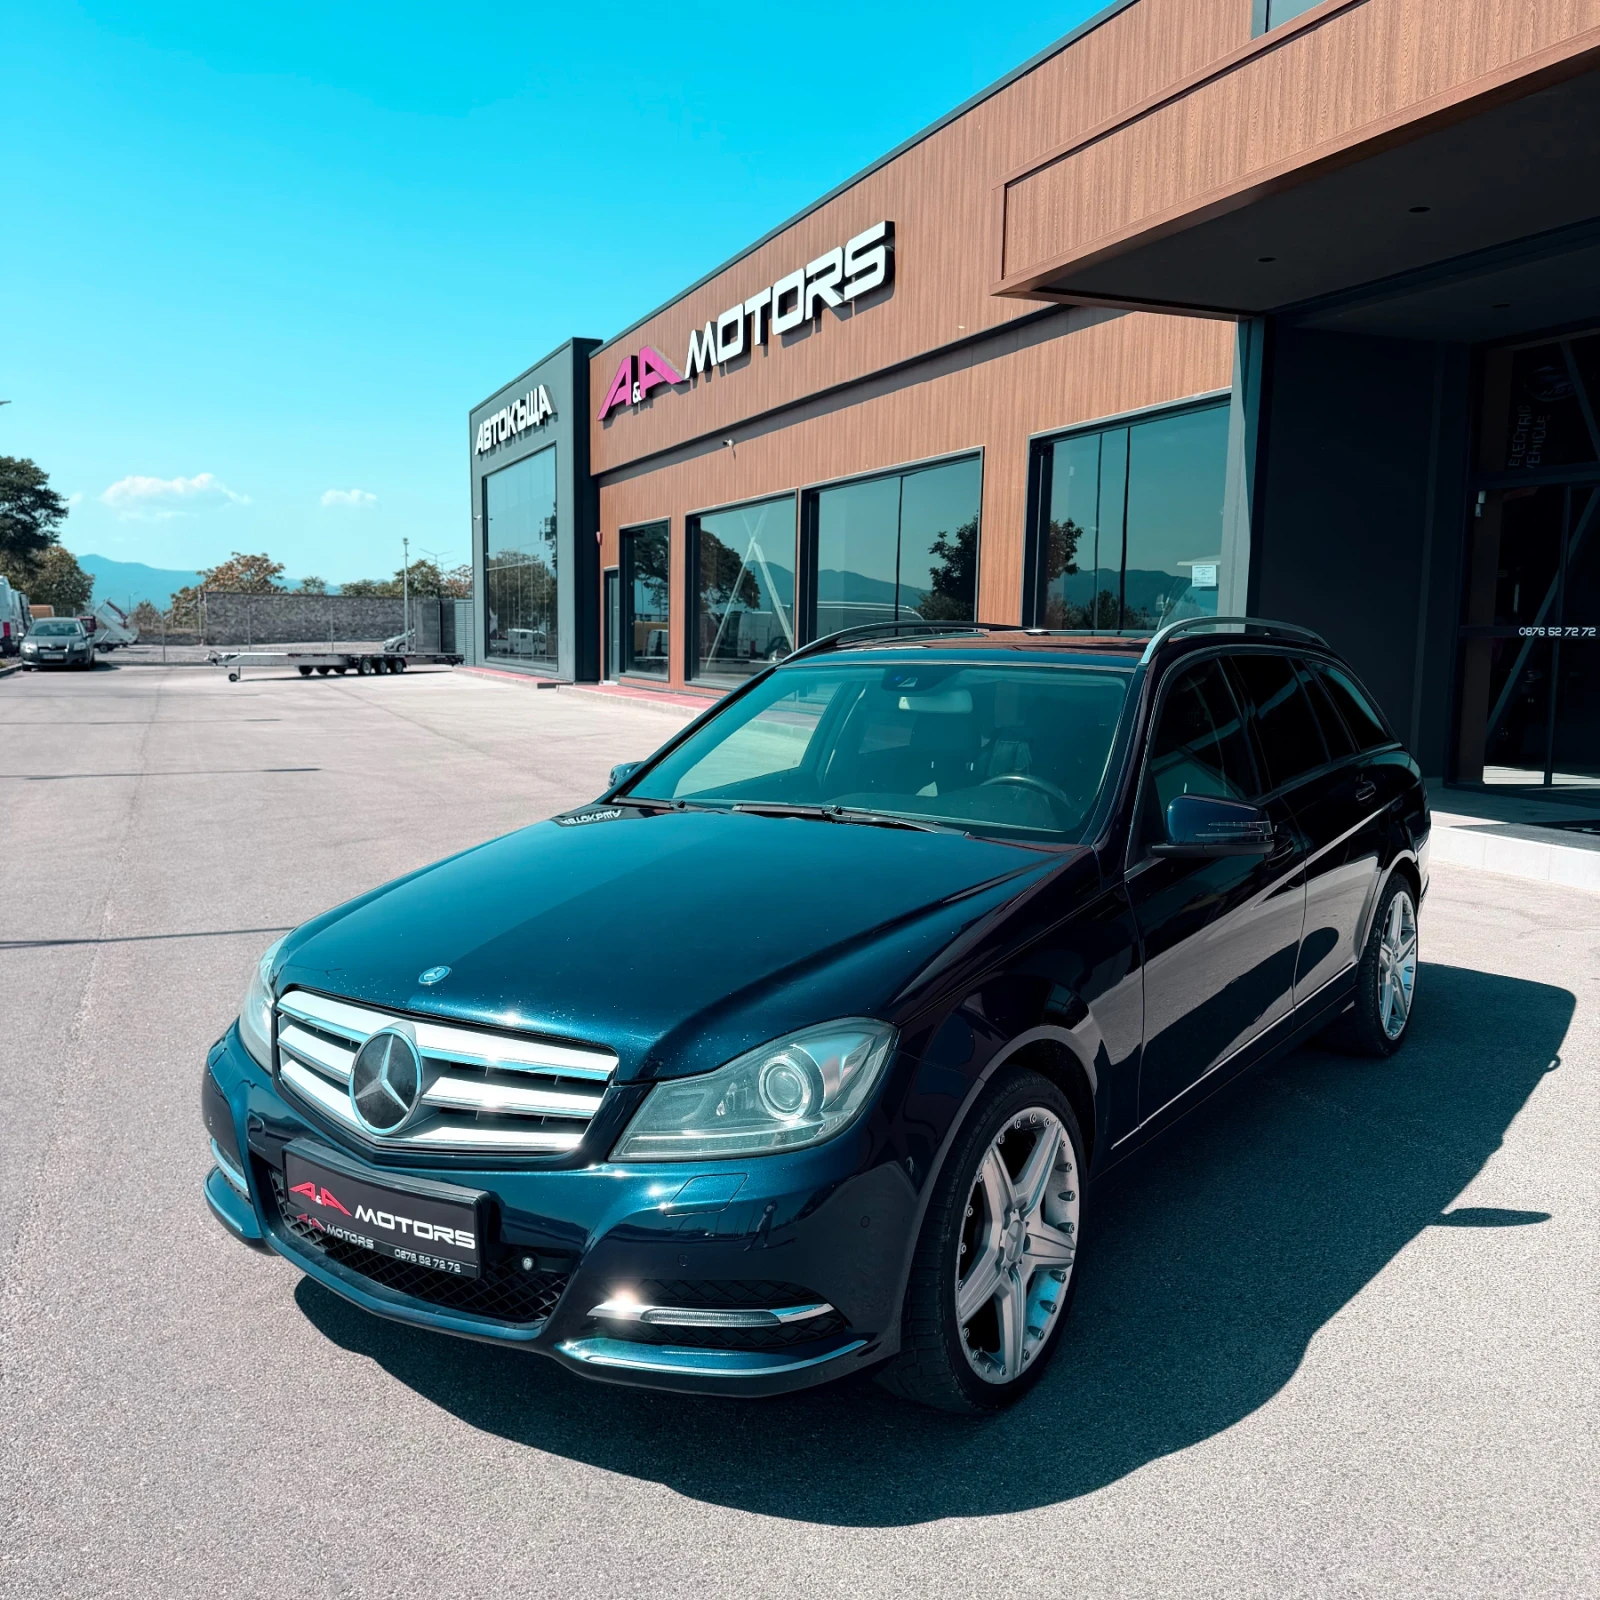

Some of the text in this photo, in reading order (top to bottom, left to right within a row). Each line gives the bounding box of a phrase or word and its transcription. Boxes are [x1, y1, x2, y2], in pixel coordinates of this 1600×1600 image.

[597, 220, 887, 421] A&A MOTORS
[474, 384, 553, 456] АВТОКЪЩА
[1508, 404, 1532, 467] ELECTRIC
[1518, 626, 1597, 637] 0876 52 72 72
[289, 1181, 476, 1250] A&A MOTORS
[326, 1223, 375, 1250] MOTORS
[432, 1258, 446, 1270] 72
[447, 1261, 462, 1274] 72
